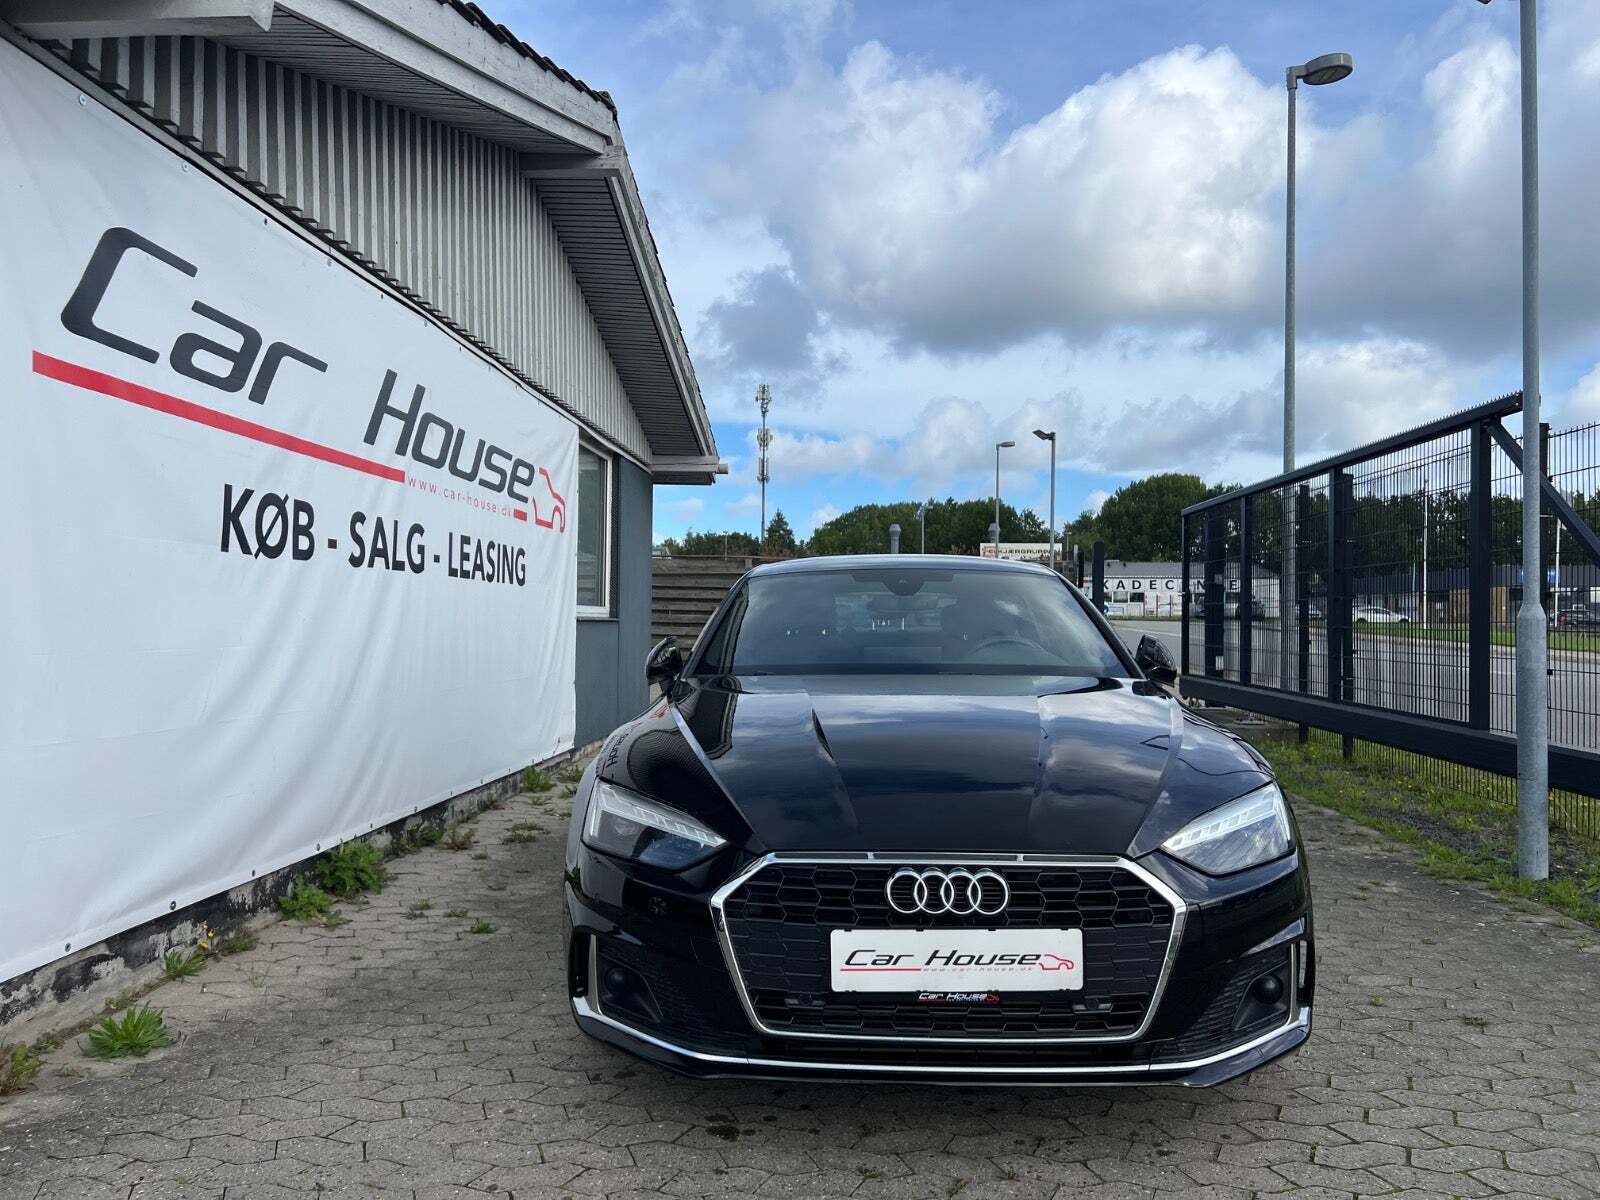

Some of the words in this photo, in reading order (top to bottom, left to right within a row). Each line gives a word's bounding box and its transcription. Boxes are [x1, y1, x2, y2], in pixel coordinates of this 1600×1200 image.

[60, 226, 329, 406] Car
[363, 368, 536, 505] House
[220, 483, 316, 561] KØB
[347, 511, 426, 575] SALG
[448, 531, 526, 587] LEASING
[844, 949, 914, 967] Car
[924, 949, 1042, 967] House
[918, 992, 944, 1000] Car
[946, 992, 988, 1001] House
